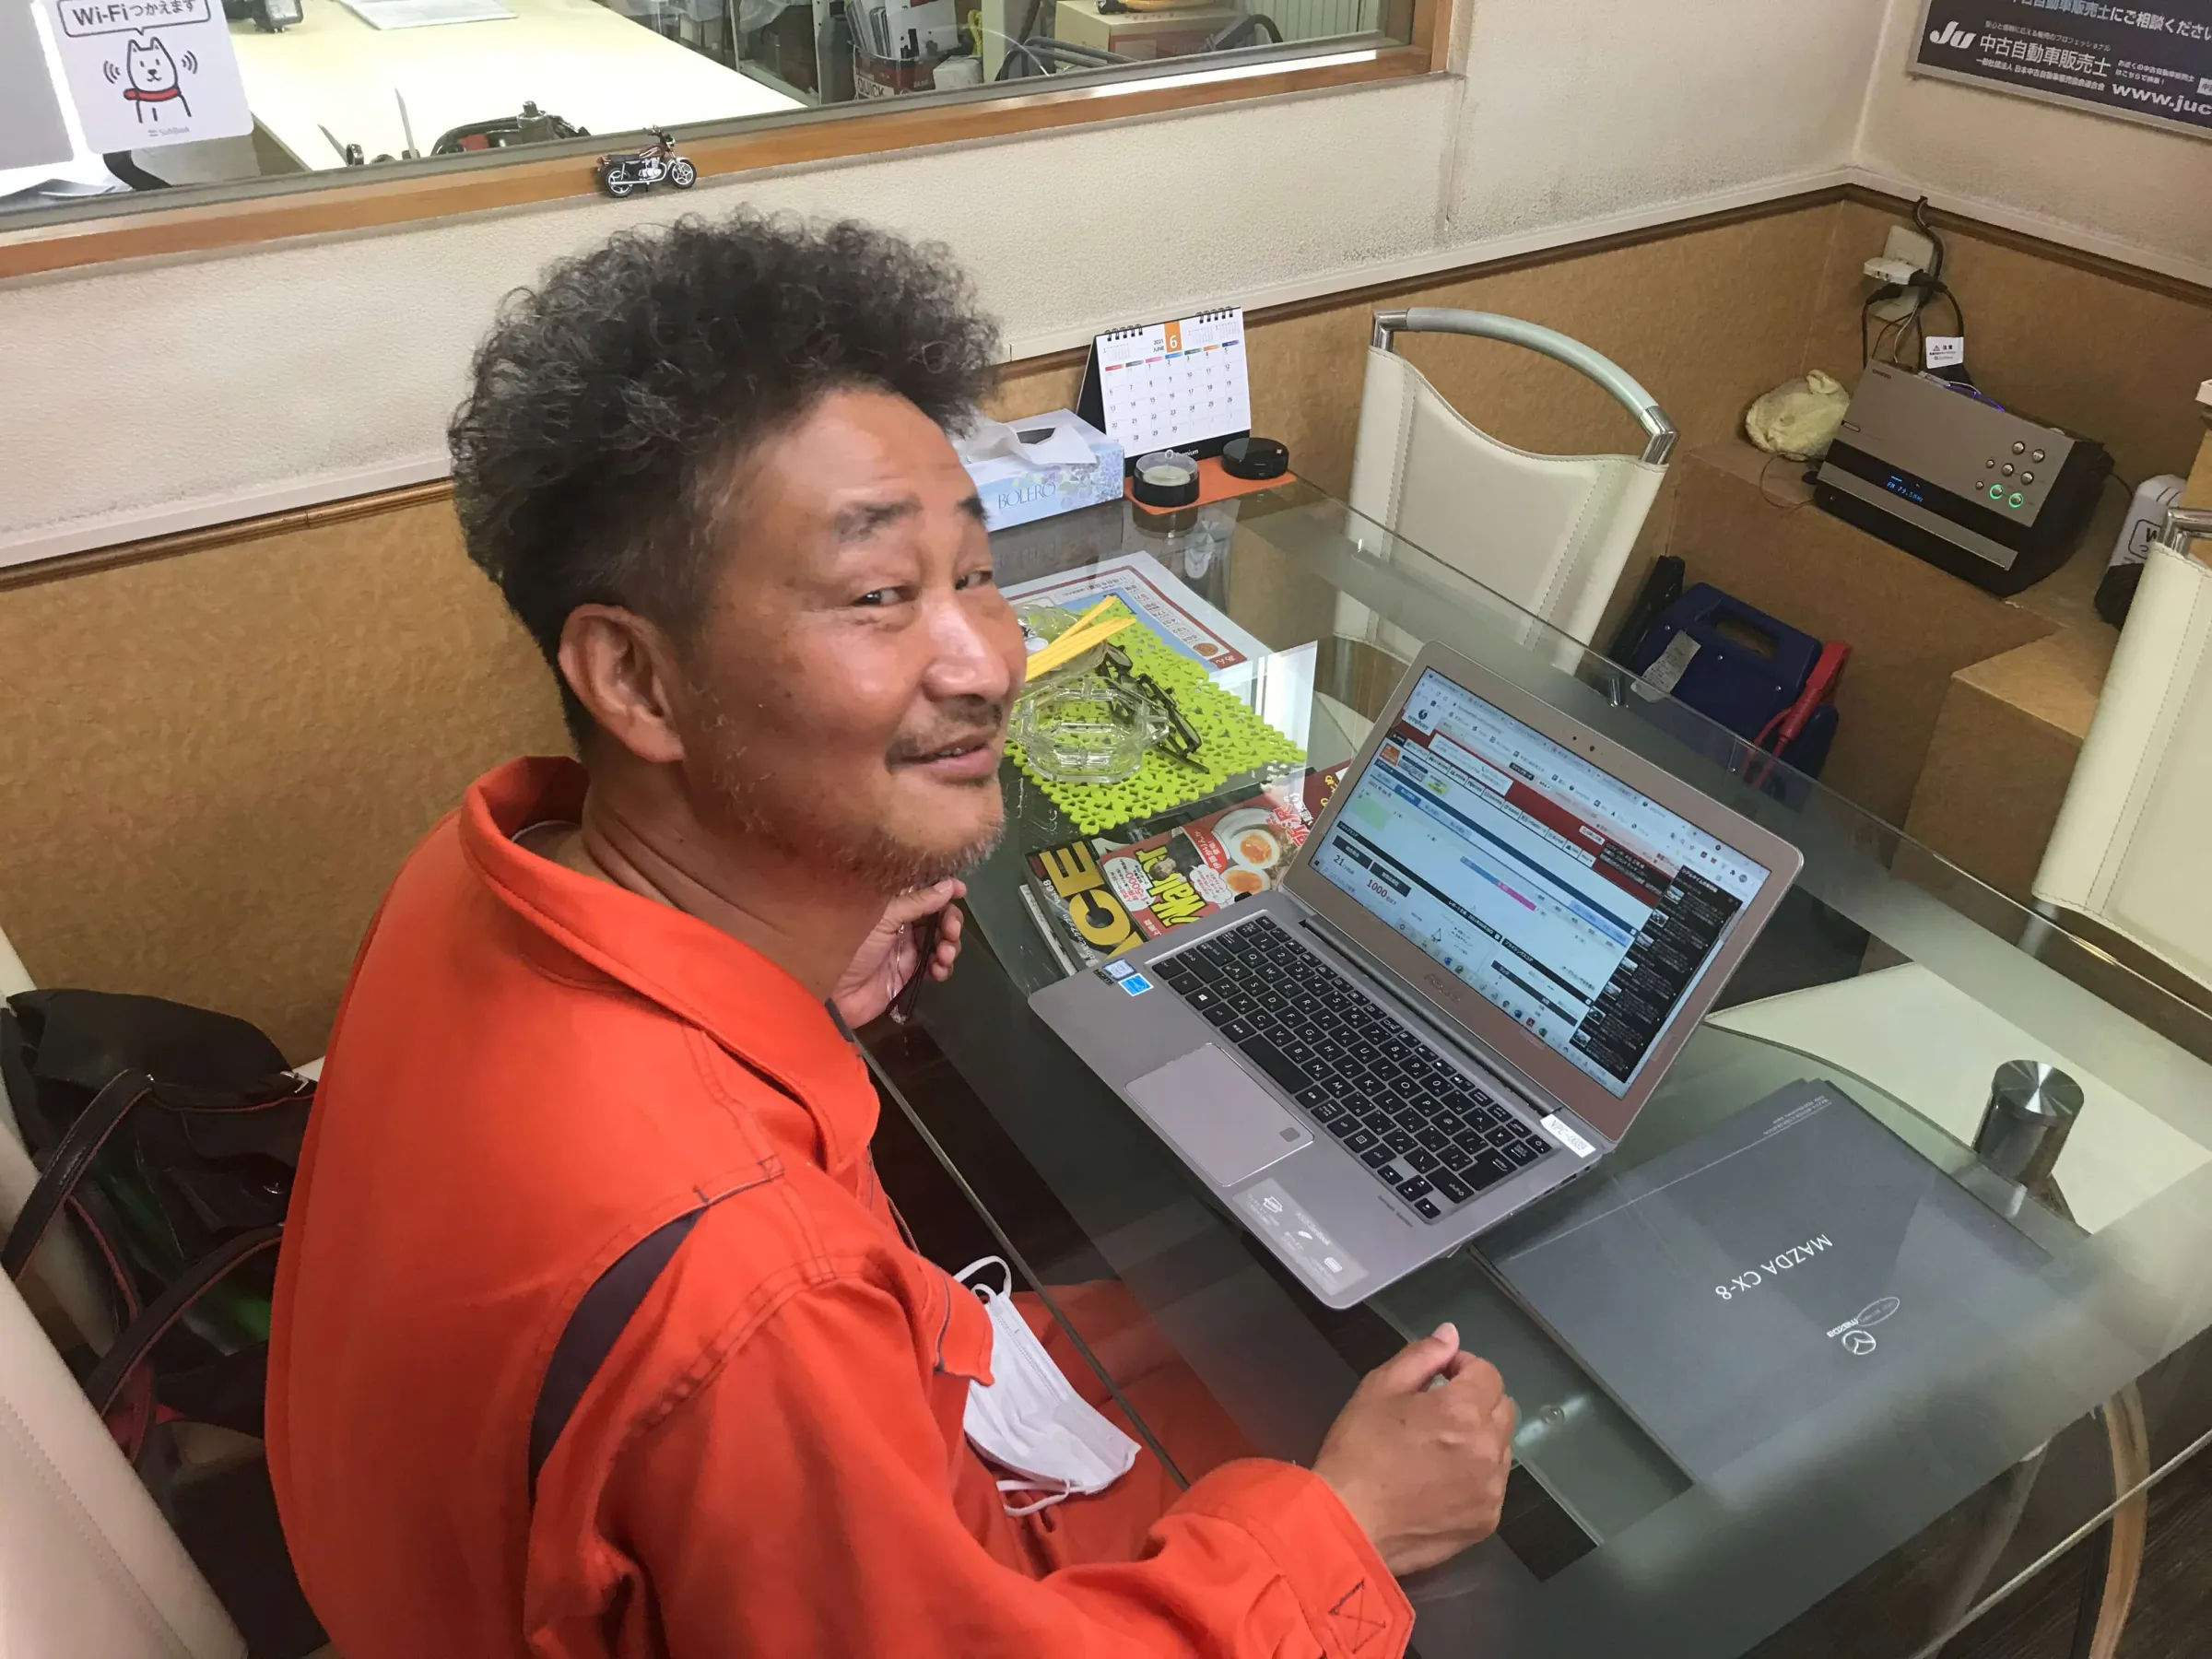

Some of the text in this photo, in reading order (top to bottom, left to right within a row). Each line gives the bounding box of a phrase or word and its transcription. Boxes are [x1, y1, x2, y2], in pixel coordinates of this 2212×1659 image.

[1980, 34, 2111, 76] 中古自動車販売士
[1169, 335, 1178, 348] 6
[997, 481, 1057, 510] BOLERO
[1406, 713, 1429, 731] symphony
[1332, 853, 1345, 866] 21
[1042, 879, 1061, 905] Vol.68
[1366, 877, 1388, 899] 1000
[1714, 1233, 1833, 1300] MAZDA CX-8
